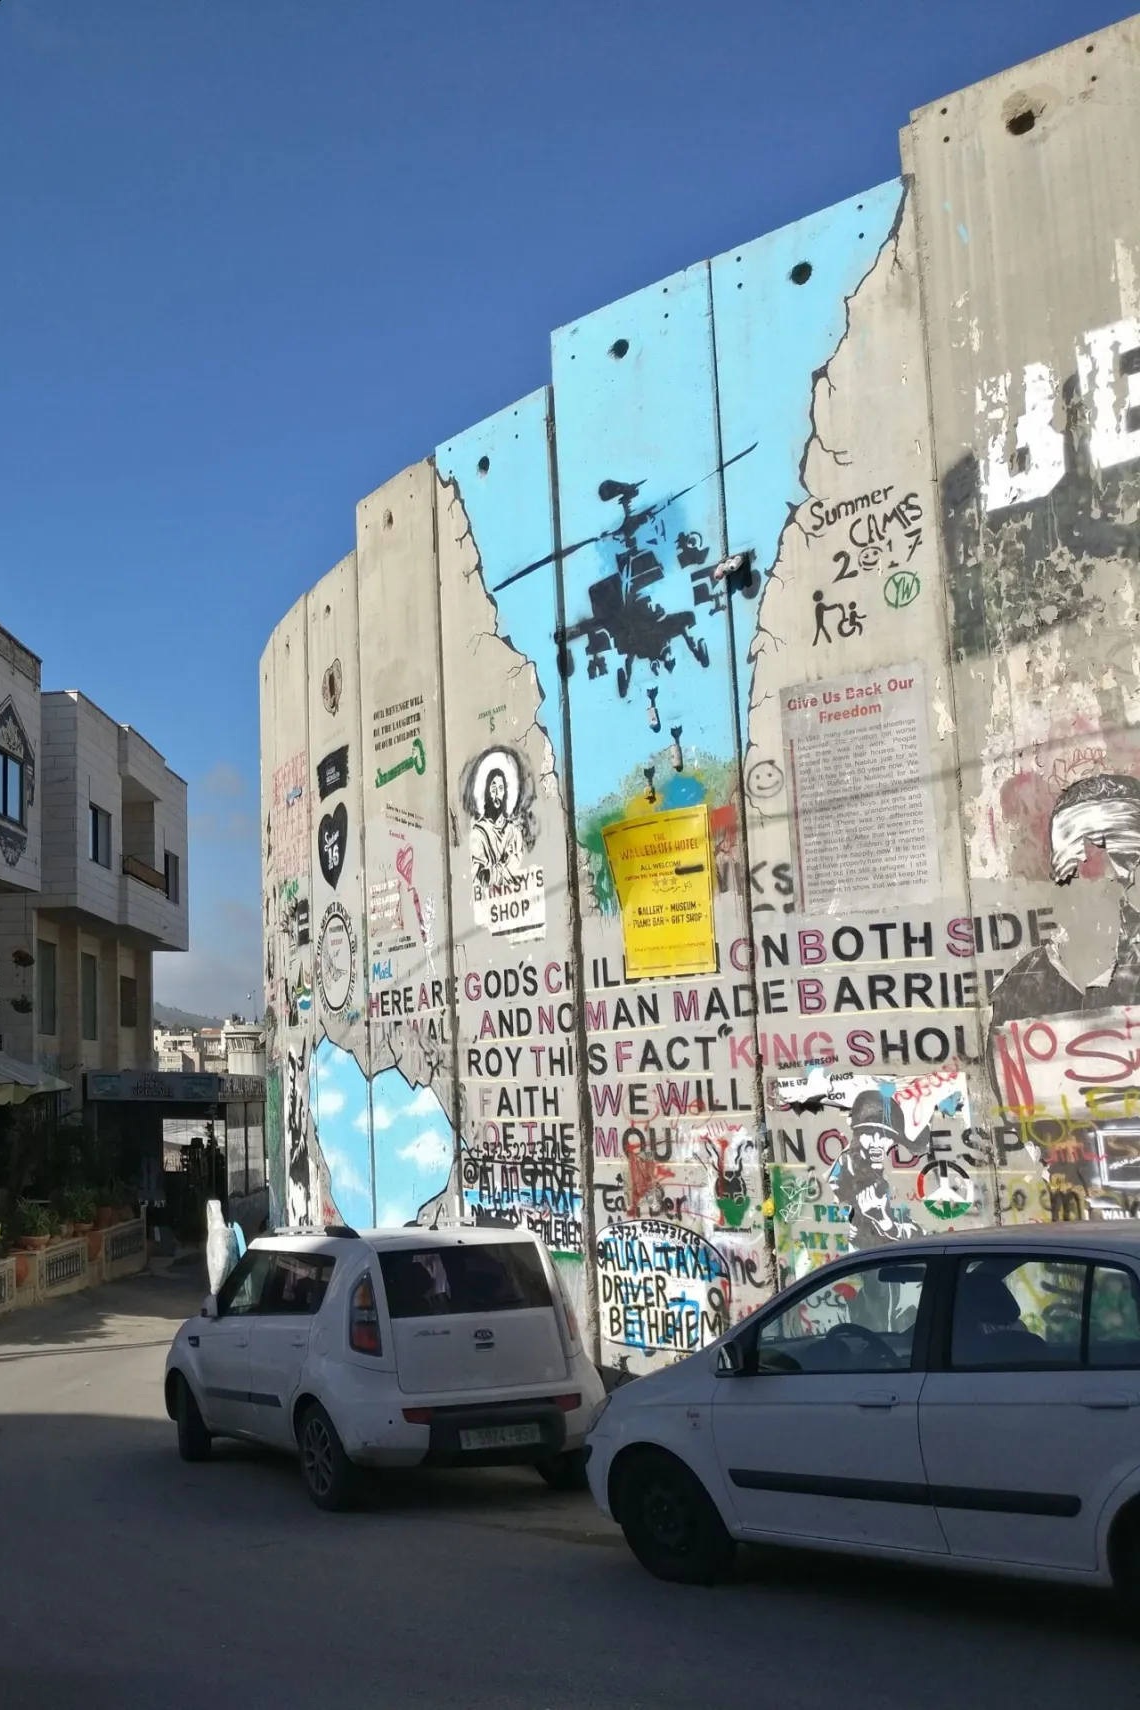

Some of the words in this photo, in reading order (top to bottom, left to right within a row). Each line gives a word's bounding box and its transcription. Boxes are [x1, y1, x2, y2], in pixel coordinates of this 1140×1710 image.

[809, 485, 895, 531] Summer
[849, 492, 923, 547] CAMPS
[386, 700, 410, 717] REVENGE
[410, 694, 424, 708] WILL
[788, 696, 818, 711] Give
[822, 692, 840, 704] Us
[846, 682, 882, 700] Back
[887, 676, 914, 692] Our
[819, 703, 882, 724] Freedom
[674, 836, 700, 852] HOTEL
[652, 860, 682, 870] WELCOME
[638, 904, 664, 916] GALLERY
[670, 901, 696, 912] MUSEUM
[672, 914, 685, 924] GIFT
[686, 912, 702, 922] SHOP
[369, 986, 415, 1018] HERE
[465, 960, 538, 1001] GOD'S
[729, 933, 790, 972] ON
[798, 922, 933, 966] BOTH
[480, 1007, 532, 1041] AND
[538, 1002, 576, 1035] NO
[585, 993, 660, 1031] MAN
[673, 978, 789, 1023] MADE
[615, 1036, 717, 1075] FACT
[479, 1085, 560, 1118] FAITH
[591, 1083, 649, 1117] WE
[656, 1077, 752, 1117] WILL
